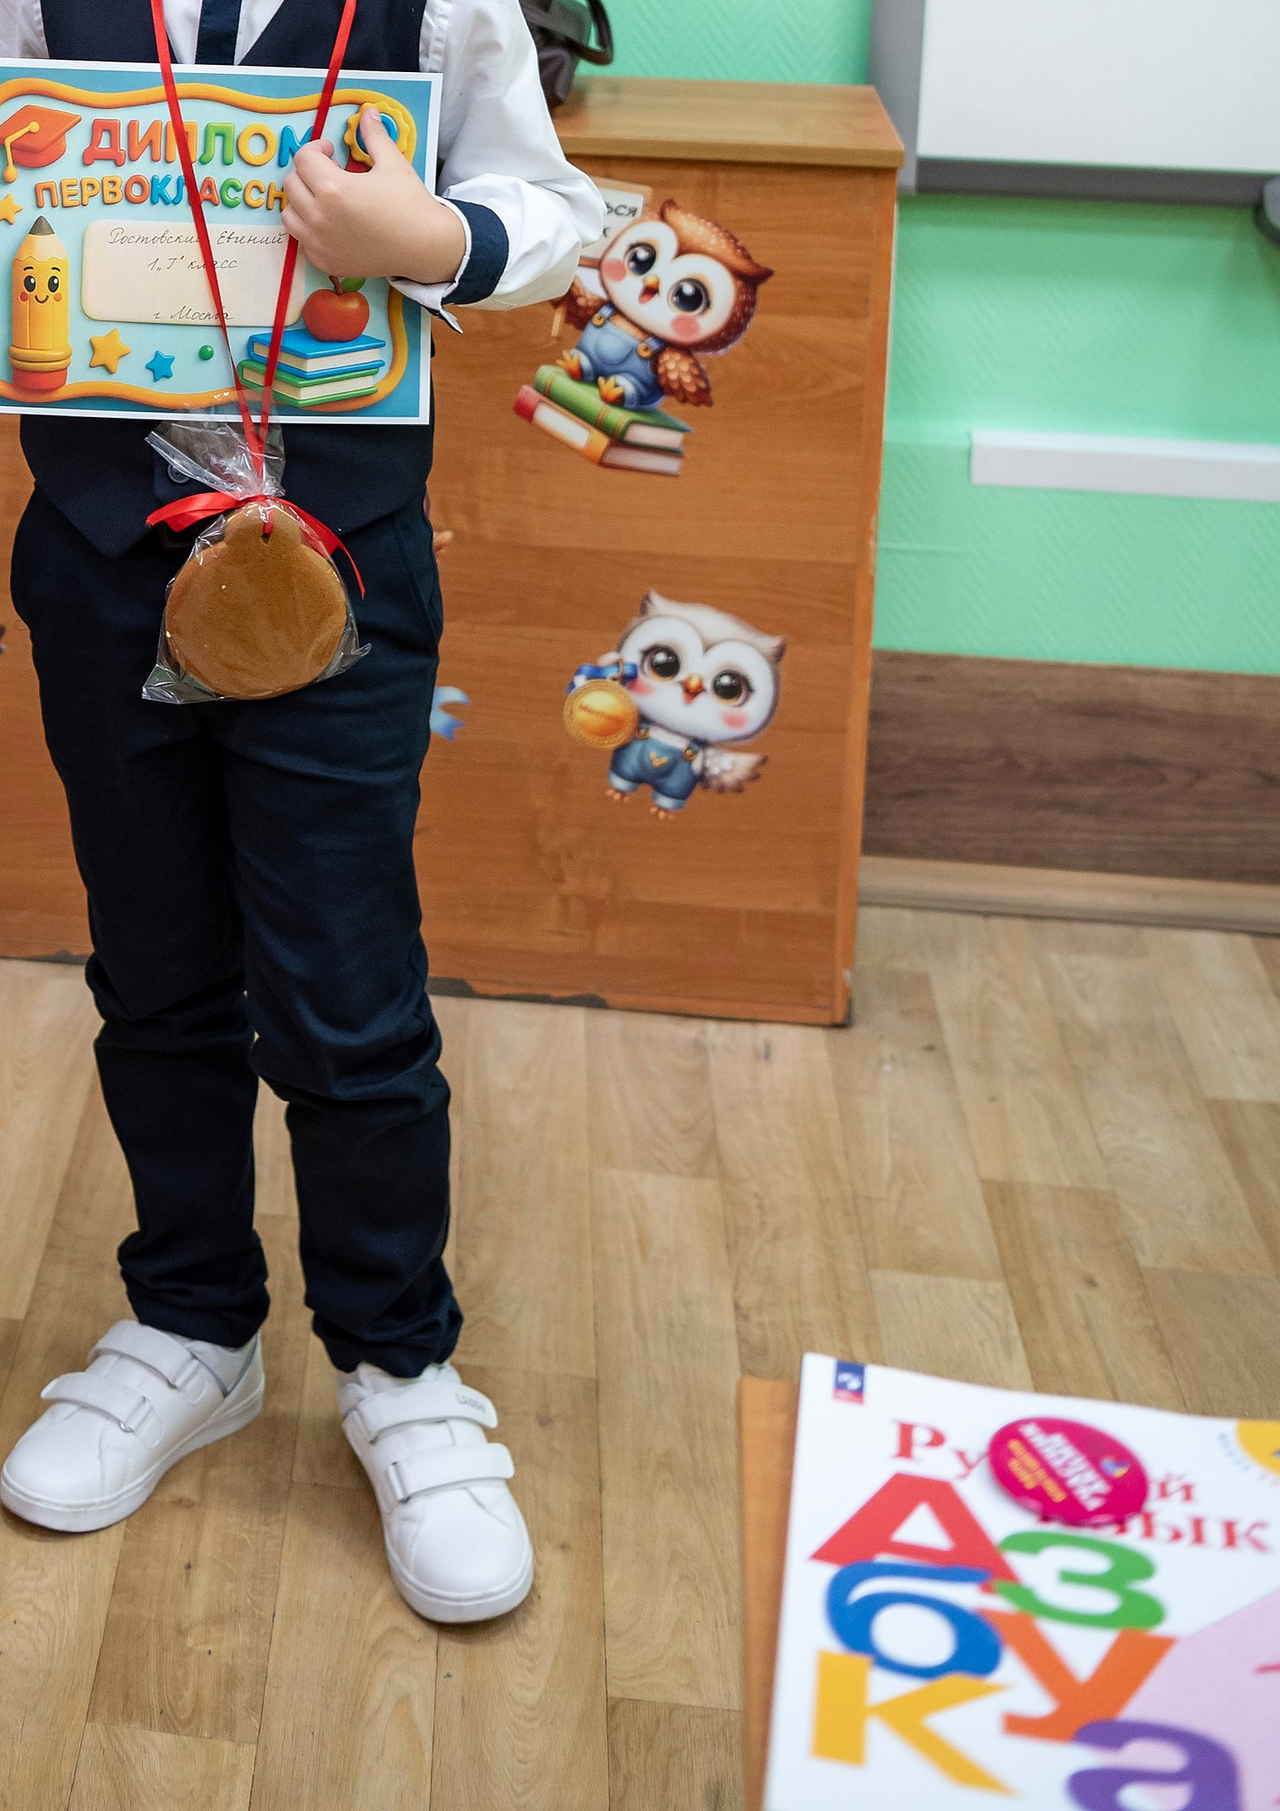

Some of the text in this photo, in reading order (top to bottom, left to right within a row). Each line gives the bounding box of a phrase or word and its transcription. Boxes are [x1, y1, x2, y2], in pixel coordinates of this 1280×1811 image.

[83, 118, 315, 168] ДИПЛОМ
[35, 174, 288, 211] ПЕРВОКЛАССН
[108, 227, 200, 246] Ростовски
